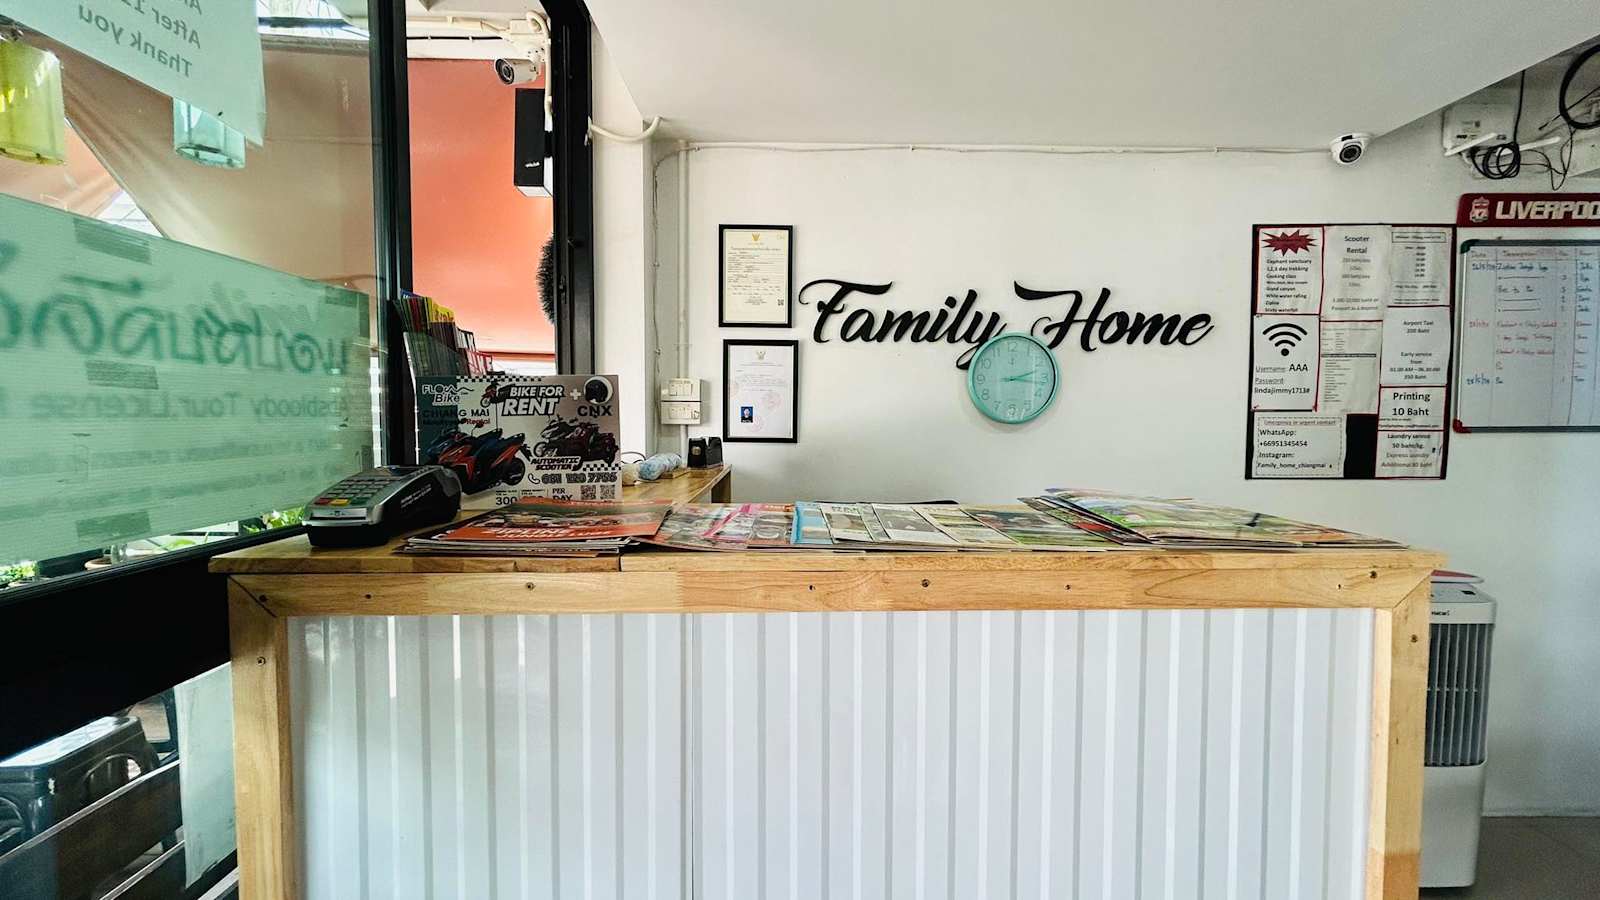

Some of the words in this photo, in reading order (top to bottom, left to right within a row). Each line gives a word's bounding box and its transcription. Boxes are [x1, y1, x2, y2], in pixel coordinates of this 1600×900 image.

[799, 278, 1007, 370] Family
[1014, 280, 1215, 352] Home
[1288, 363, 1308, 372] AAA
[509, 385, 537, 397] BIKE
[539, 385, 564, 397] FOR
[1393, 391, 1431, 402] Printing
[422, 408, 467, 417] CHIANG
[470, 408, 490, 417] MAI
[502, 398, 559, 416] RENT
[577, 405, 613, 418] CNX
[1392, 407, 1405, 416] 10
[1407, 407, 1430, 416] Baht
[530, 456, 580, 465] AUTOMATIC
